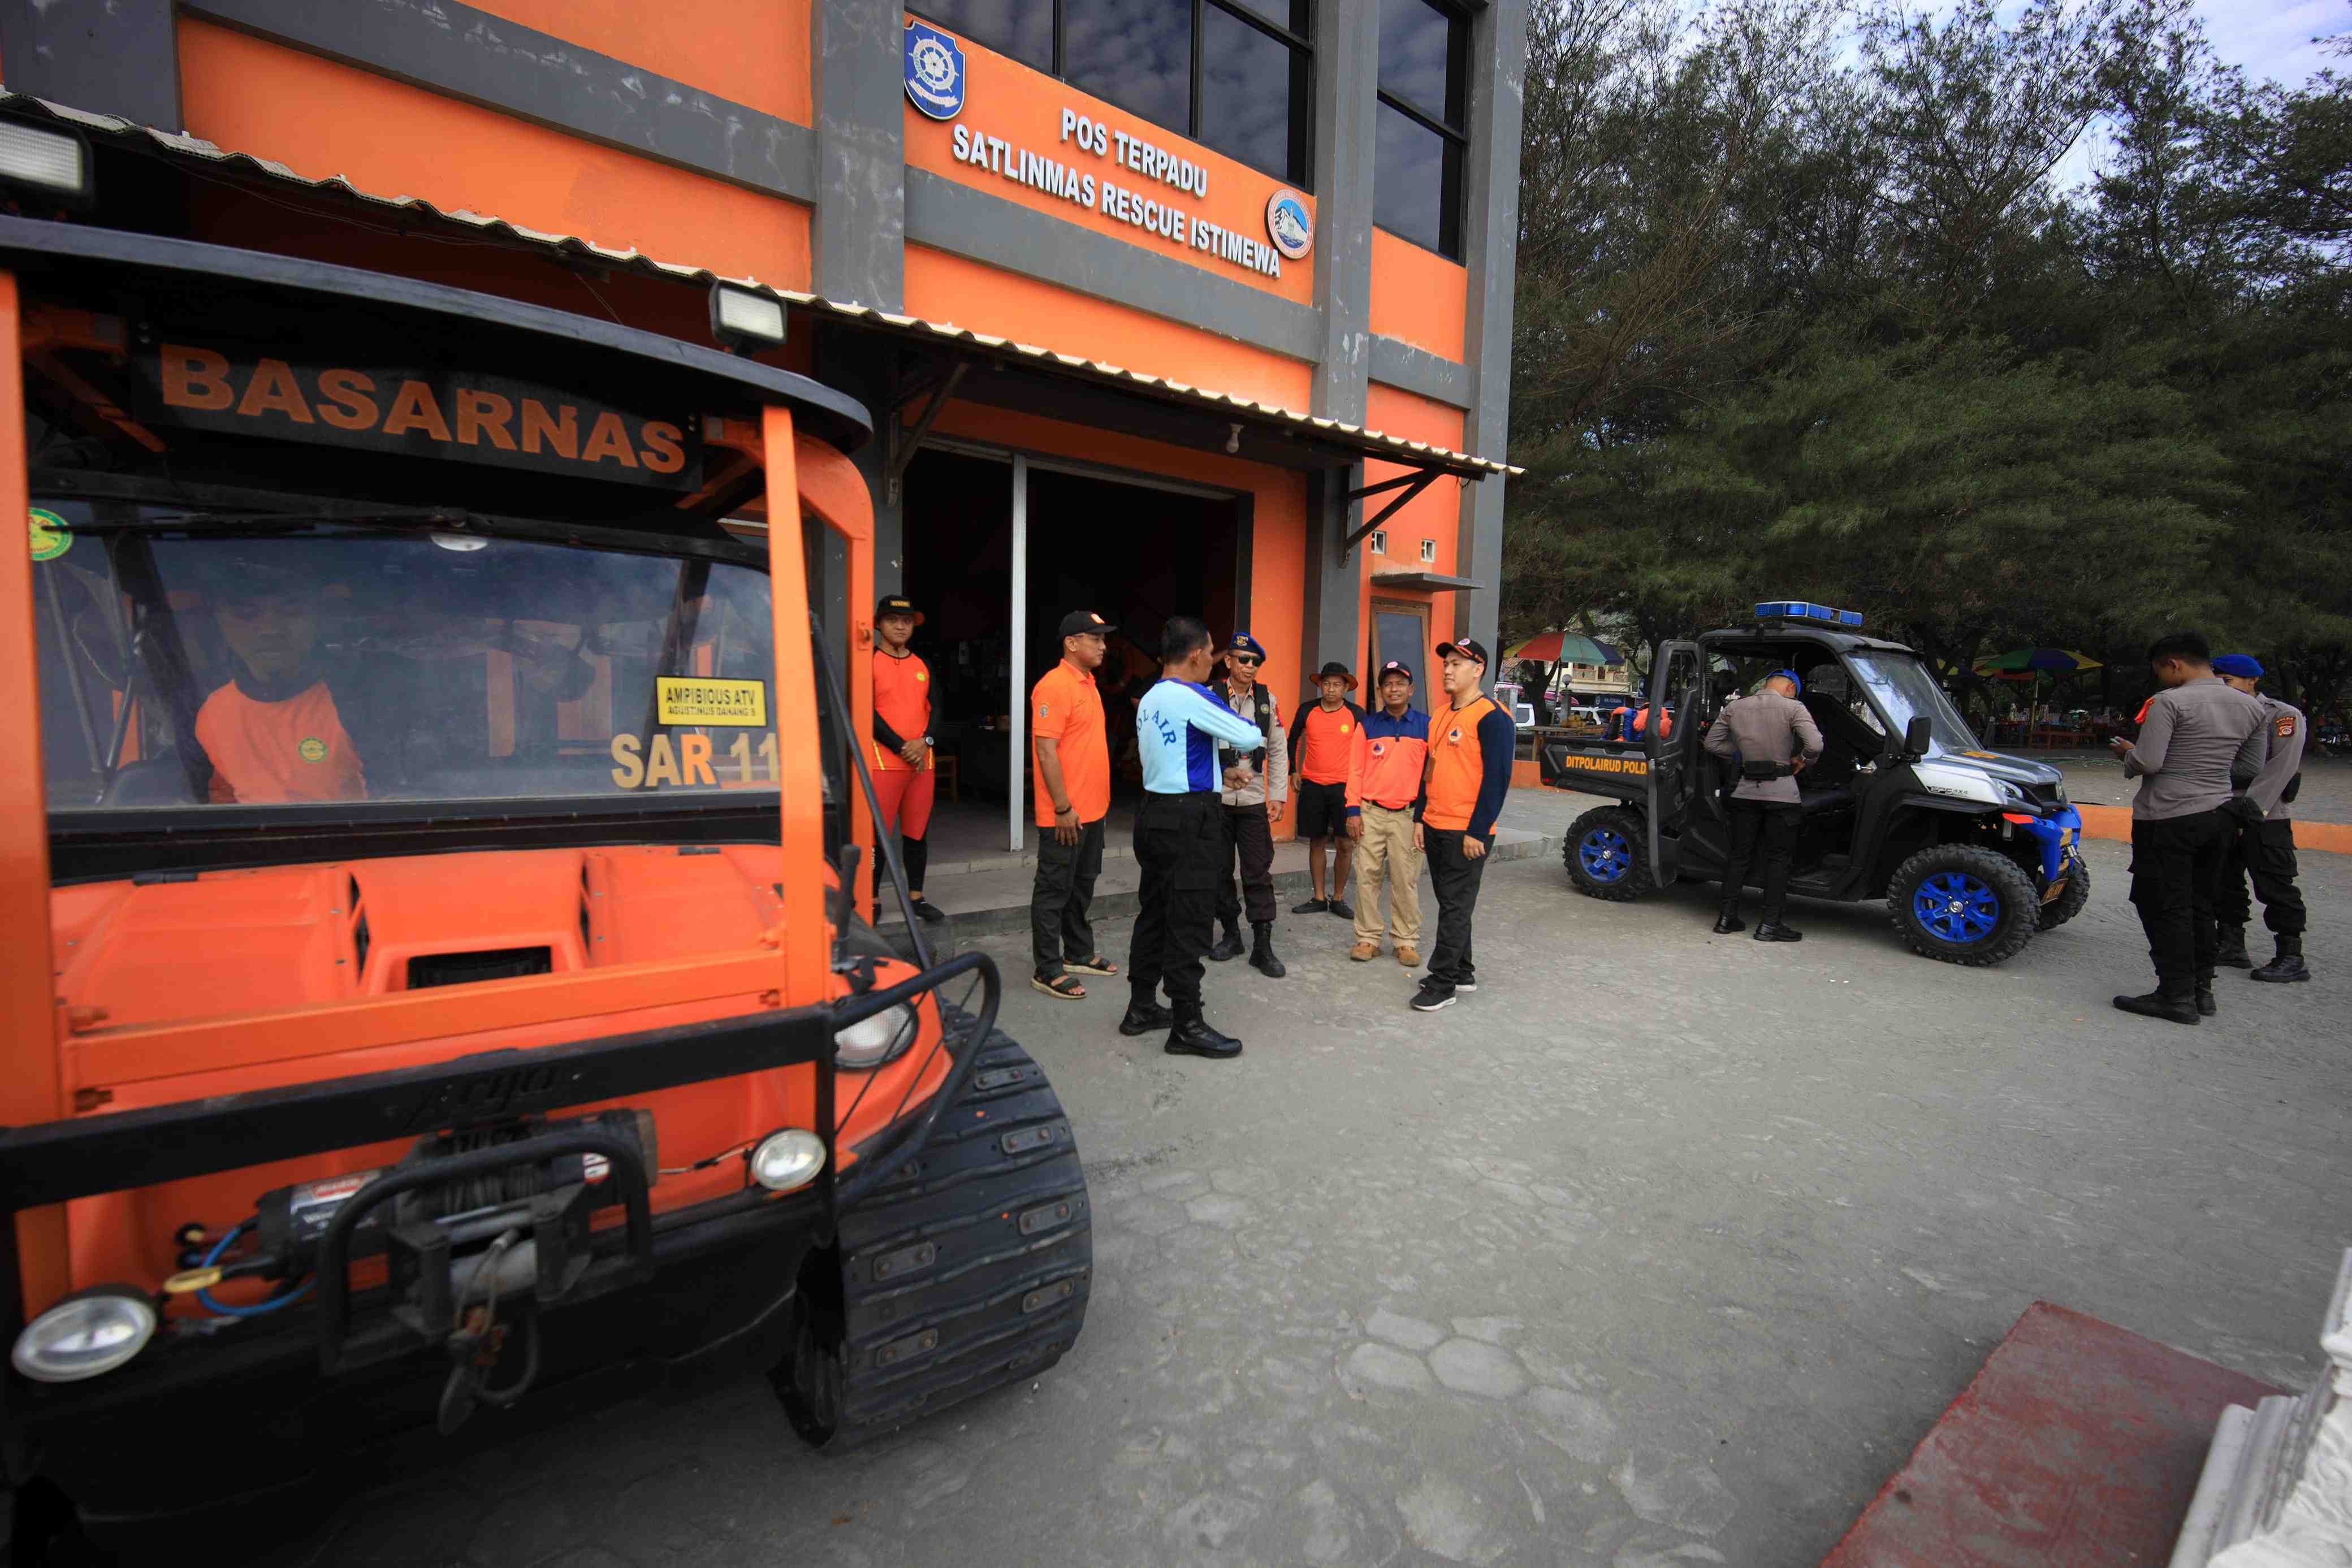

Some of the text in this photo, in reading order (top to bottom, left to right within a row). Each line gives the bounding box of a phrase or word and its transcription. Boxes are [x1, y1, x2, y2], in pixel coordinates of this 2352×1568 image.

[1062, 107, 1208, 198] POS TERPADU
[953, 124, 1096, 208] SATLINMAS
[1102, 180, 1186, 242] RESCUE
[1191, 216, 1281, 279] ISTIMEWA
[160, 343, 686, 474] BASARNAS
[665, 687, 755, 705] AMPIBIOUS ATV
[611, 733, 779, 789] SAR 11
[1565, 755, 1647, 775] DITPOLAIRUD POLD
